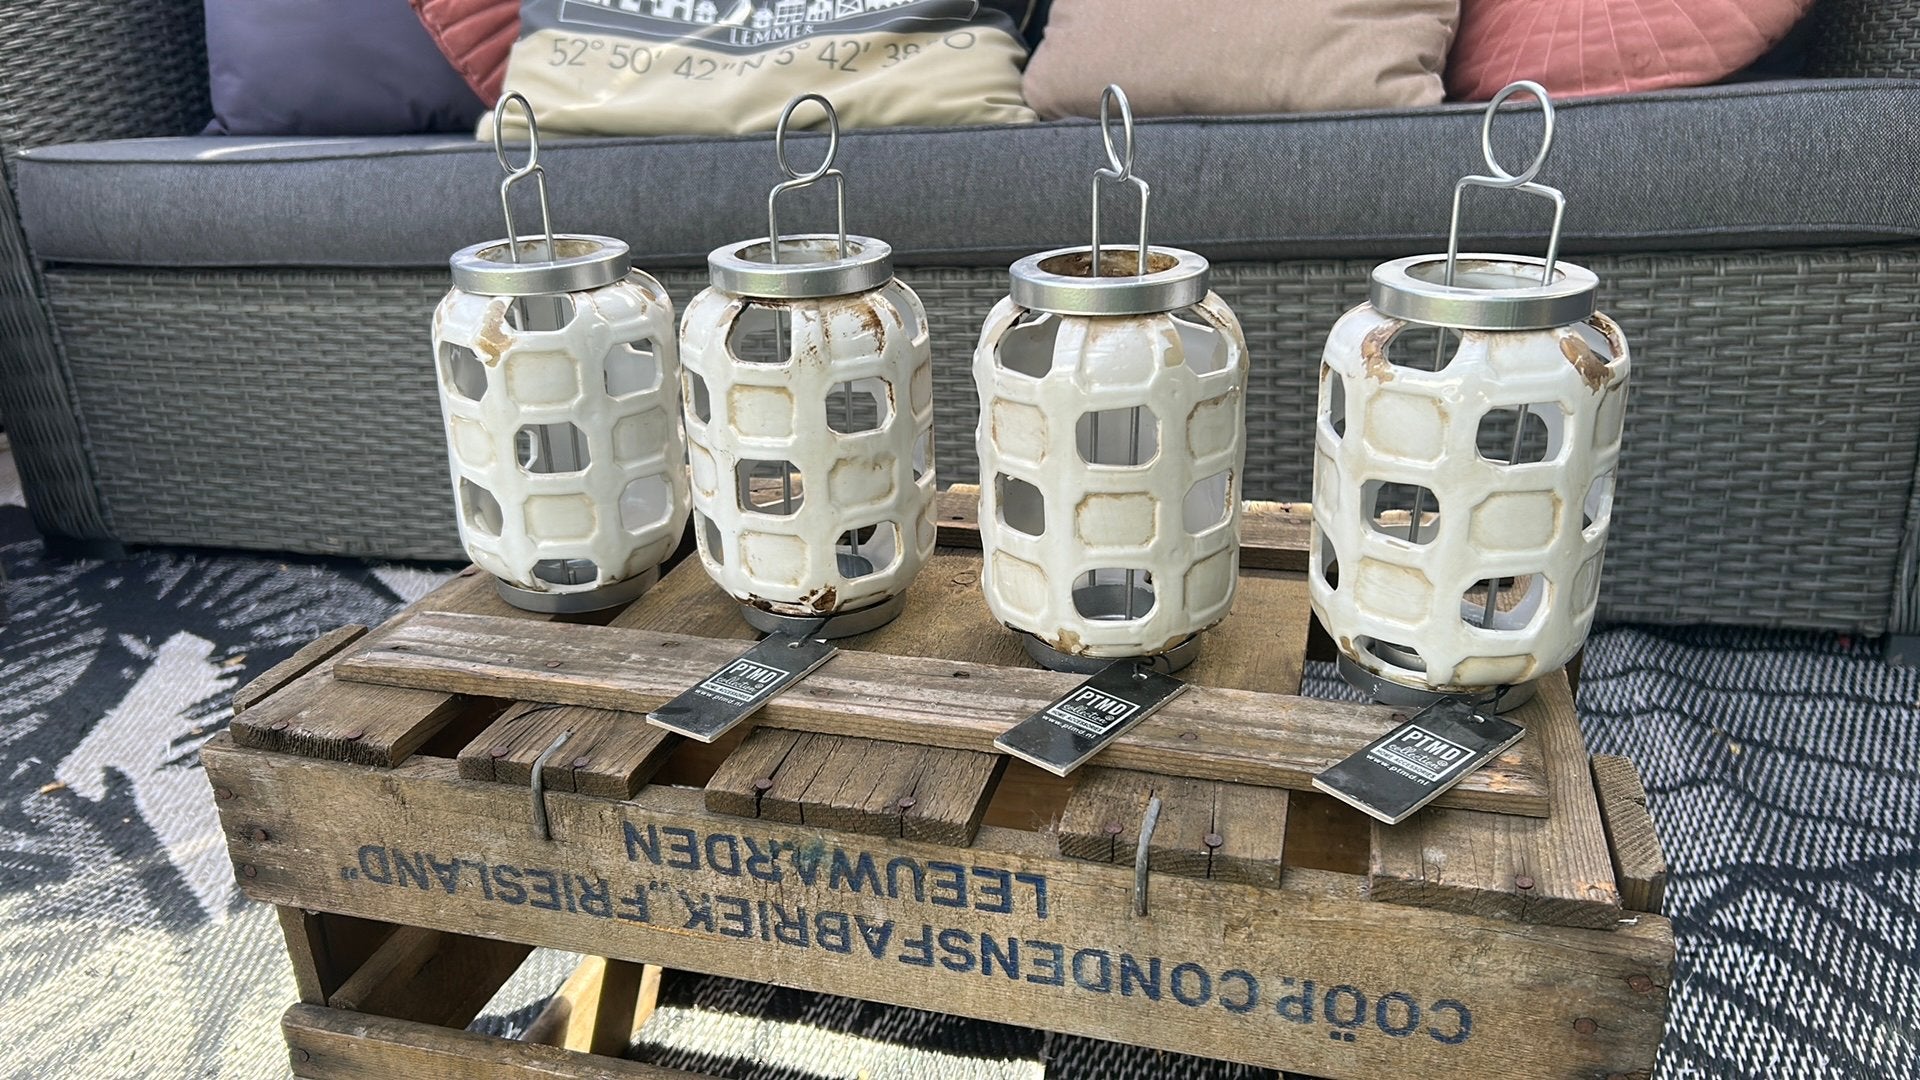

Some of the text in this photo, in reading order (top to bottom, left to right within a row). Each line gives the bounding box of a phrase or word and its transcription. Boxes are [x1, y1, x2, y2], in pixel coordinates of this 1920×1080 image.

[728, 662, 779, 685] PTMD
[694, 688, 745, 707] www.ptmd.nl
[1074, 690, 1128, 716] PTMD
[1041, 715, 1097, 739] www.ptmd.nl
[1401, 729, 1462, 761] PTMD
[1366, 754, 1430, 786] www.ptmd.nl
[623, 819, 1048, 920] LEEUWARDEN
[677, 888, 1260, 1014] CONDENSFABRIEK
